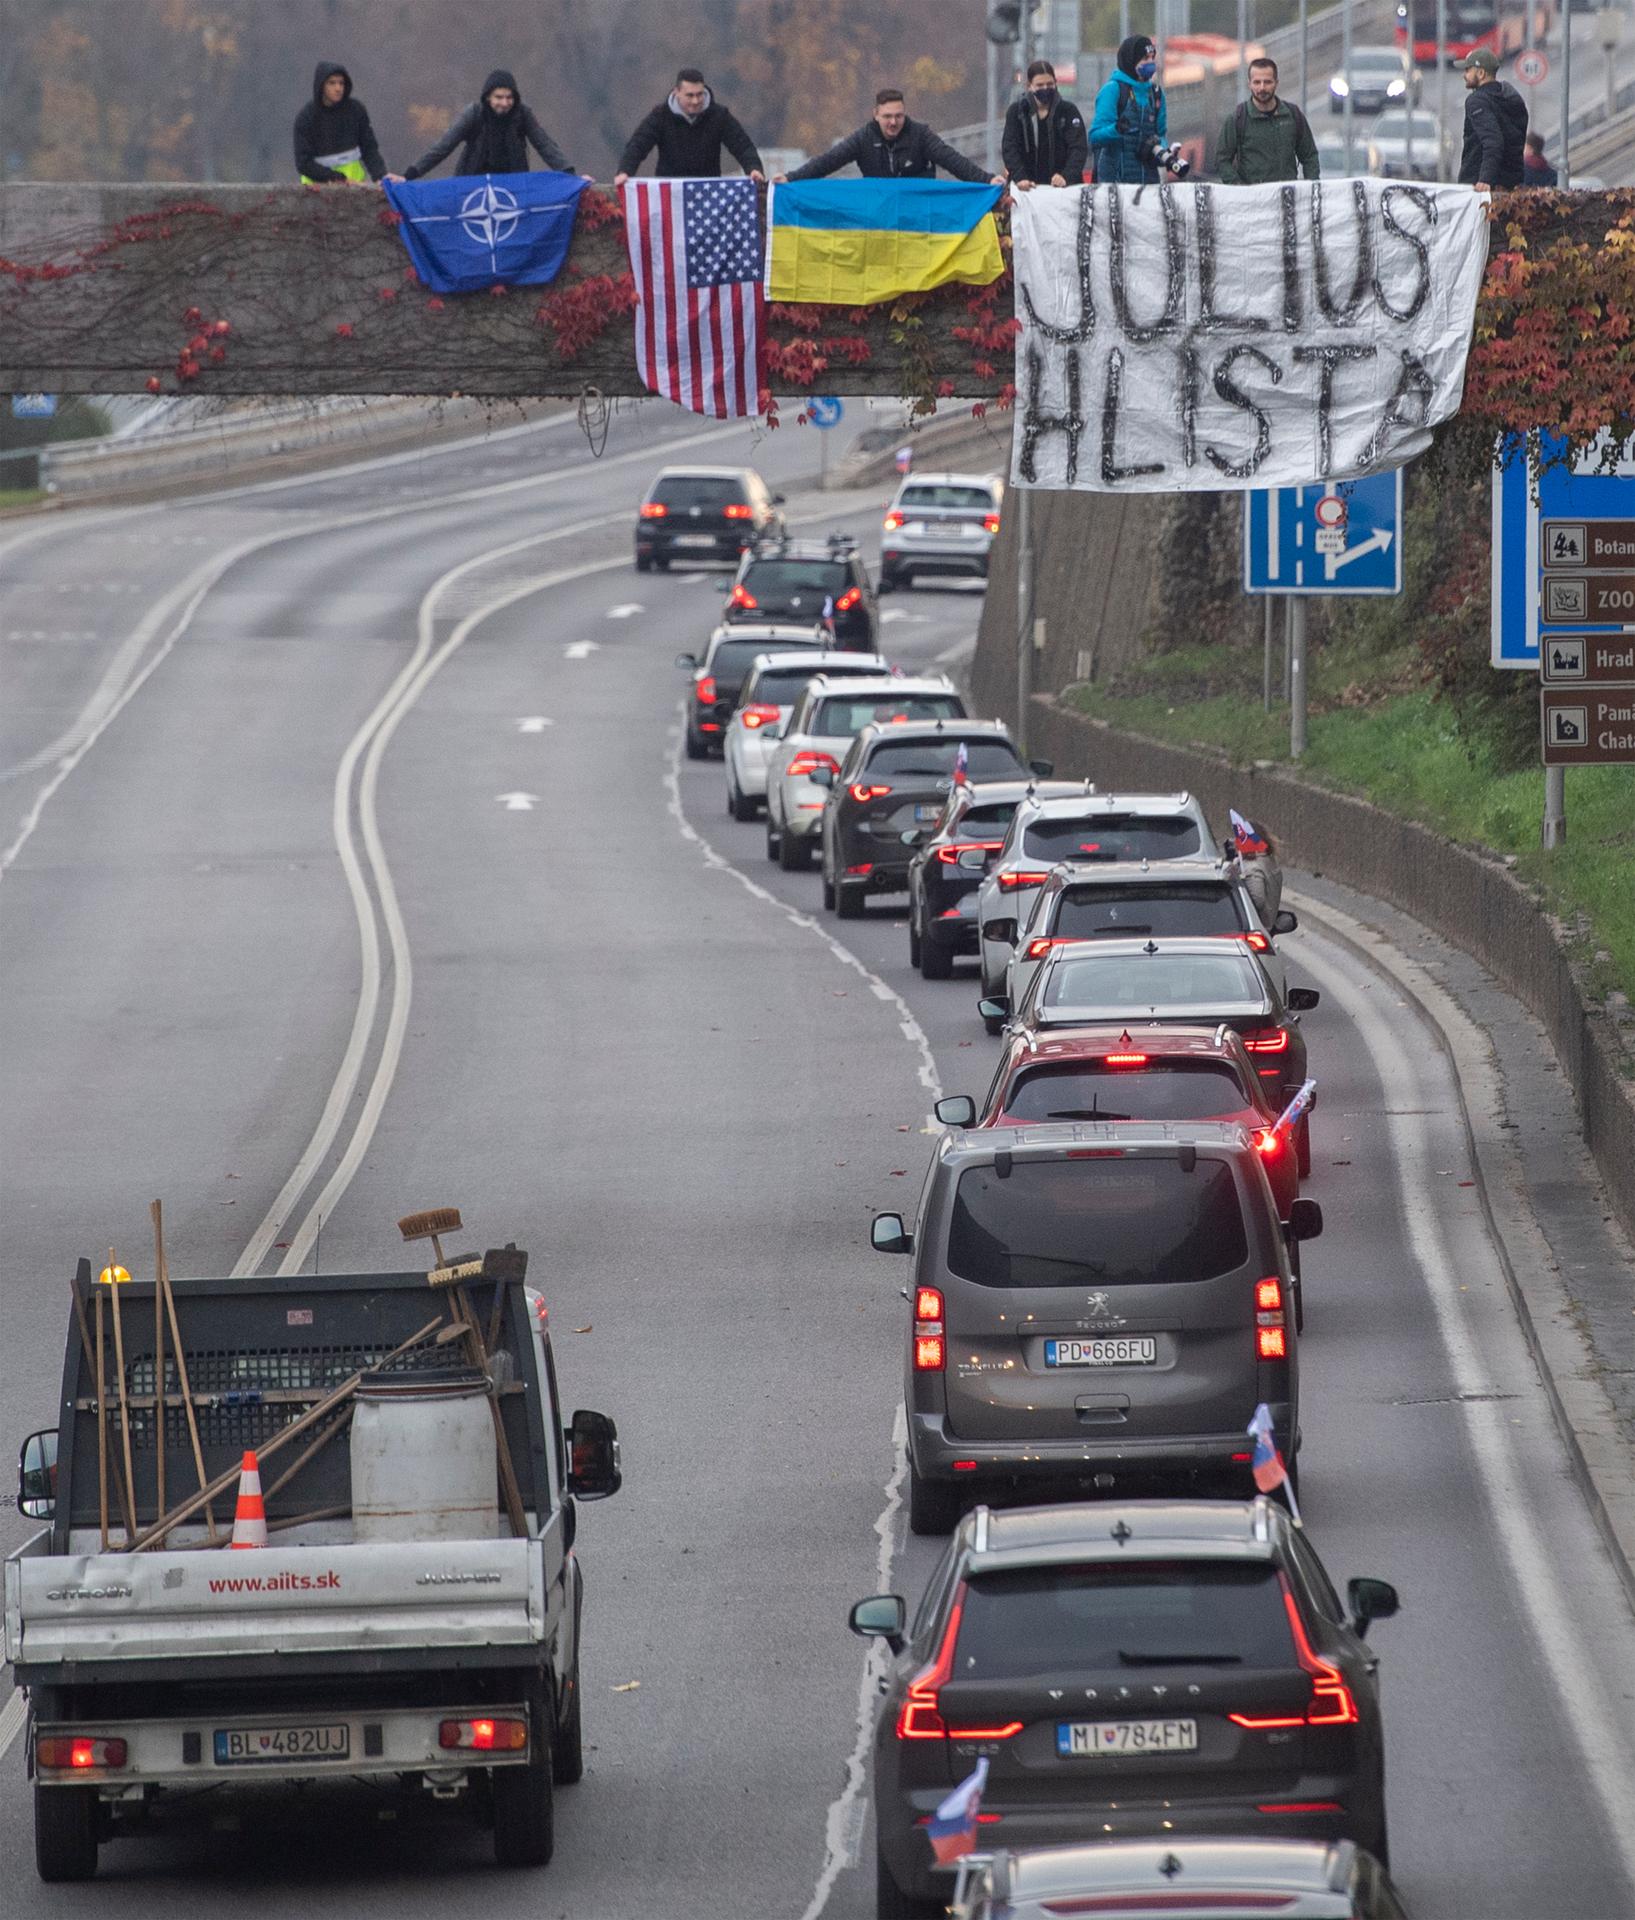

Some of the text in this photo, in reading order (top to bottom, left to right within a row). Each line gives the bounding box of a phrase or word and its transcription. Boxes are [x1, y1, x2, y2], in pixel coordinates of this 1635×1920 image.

[1019, 344, 1434, 484] HLISTA
[1598, 590, 1634, 609] ZOO
[1596, 648, 1634, 668] Hrad
[1598, 731, 1635, 749] Chat
[208, 1570, 342, 1593] www.aiits.sk
